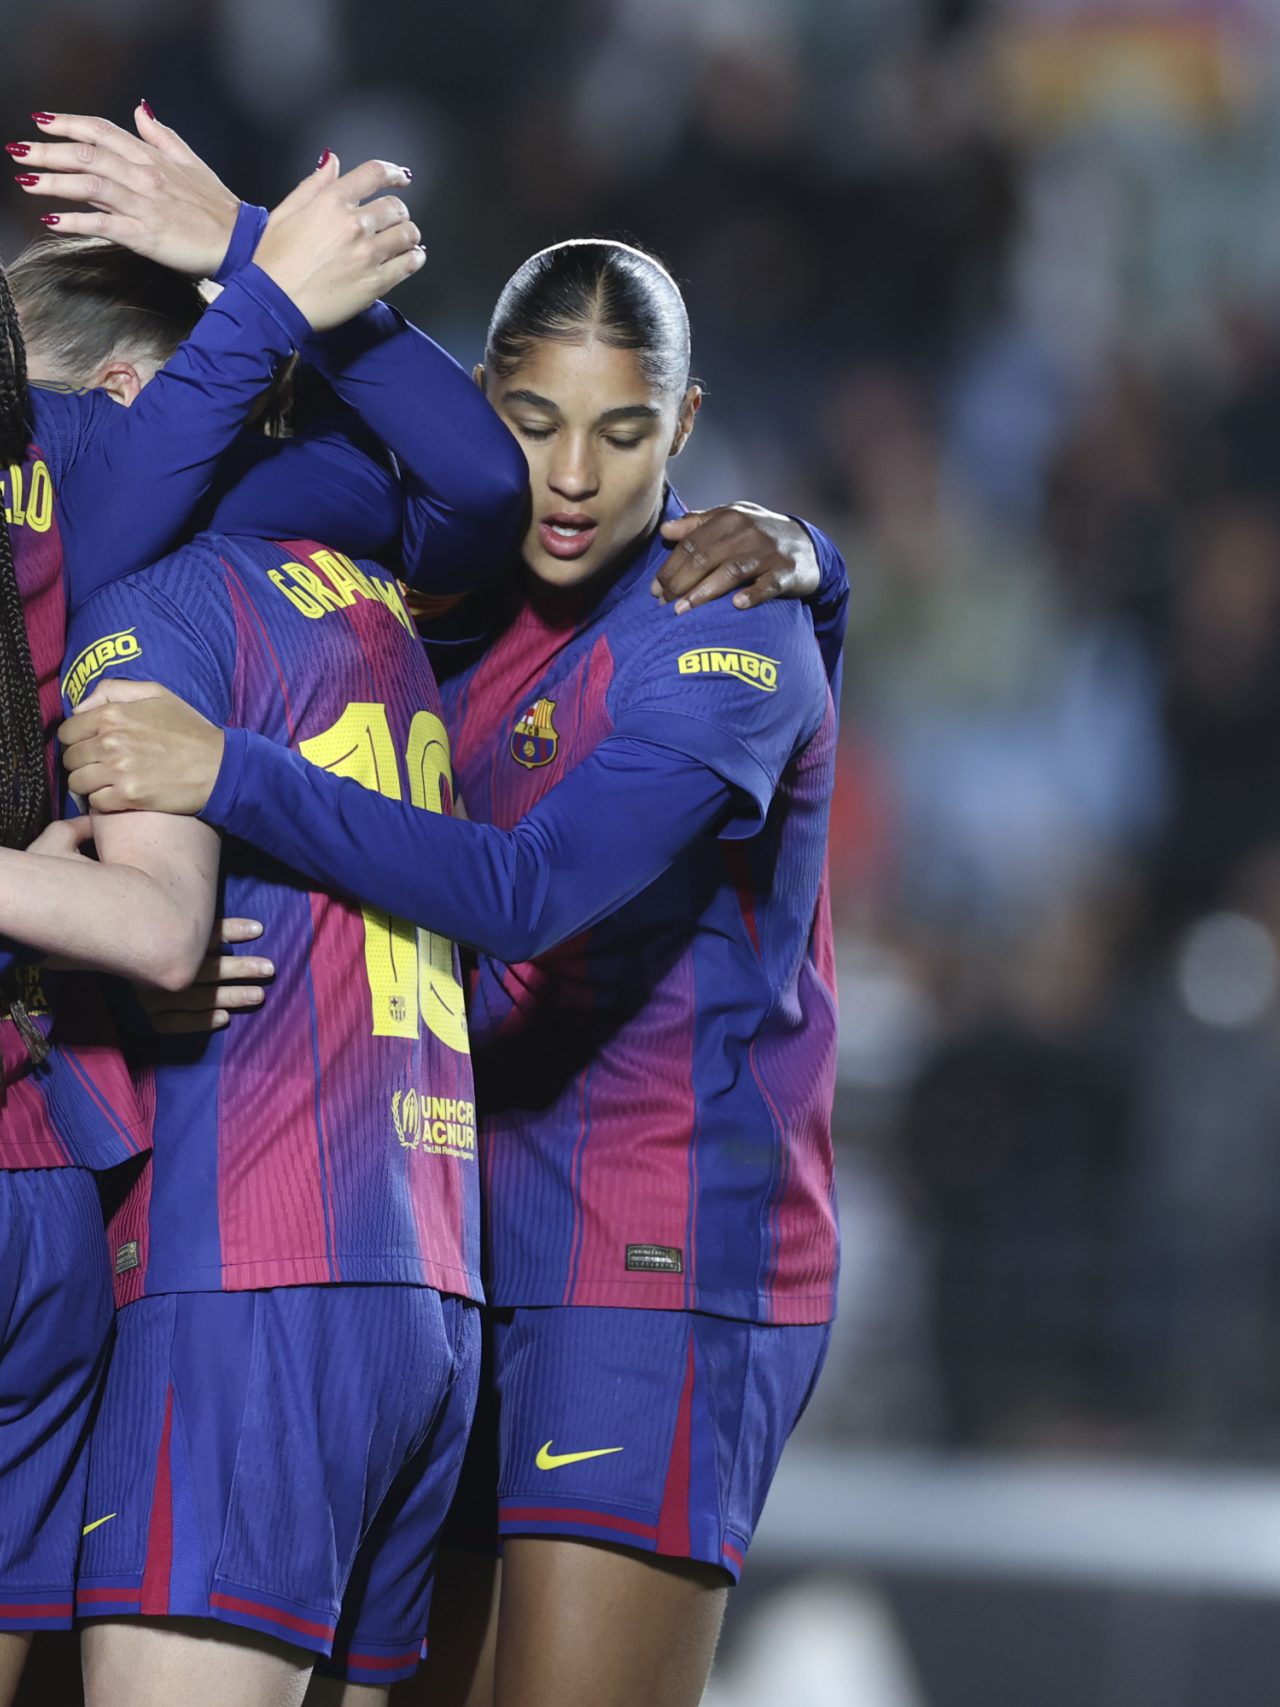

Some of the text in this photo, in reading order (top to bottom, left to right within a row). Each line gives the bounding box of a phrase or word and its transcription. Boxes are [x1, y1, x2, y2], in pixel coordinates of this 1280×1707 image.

[67, 634, 138, 707] BIMBO
[678, 651, 777, 686] BIMBO
[421, 1095, 474, 1126] UNHCR
[422, 1120, 475, 1150] ACNUR
